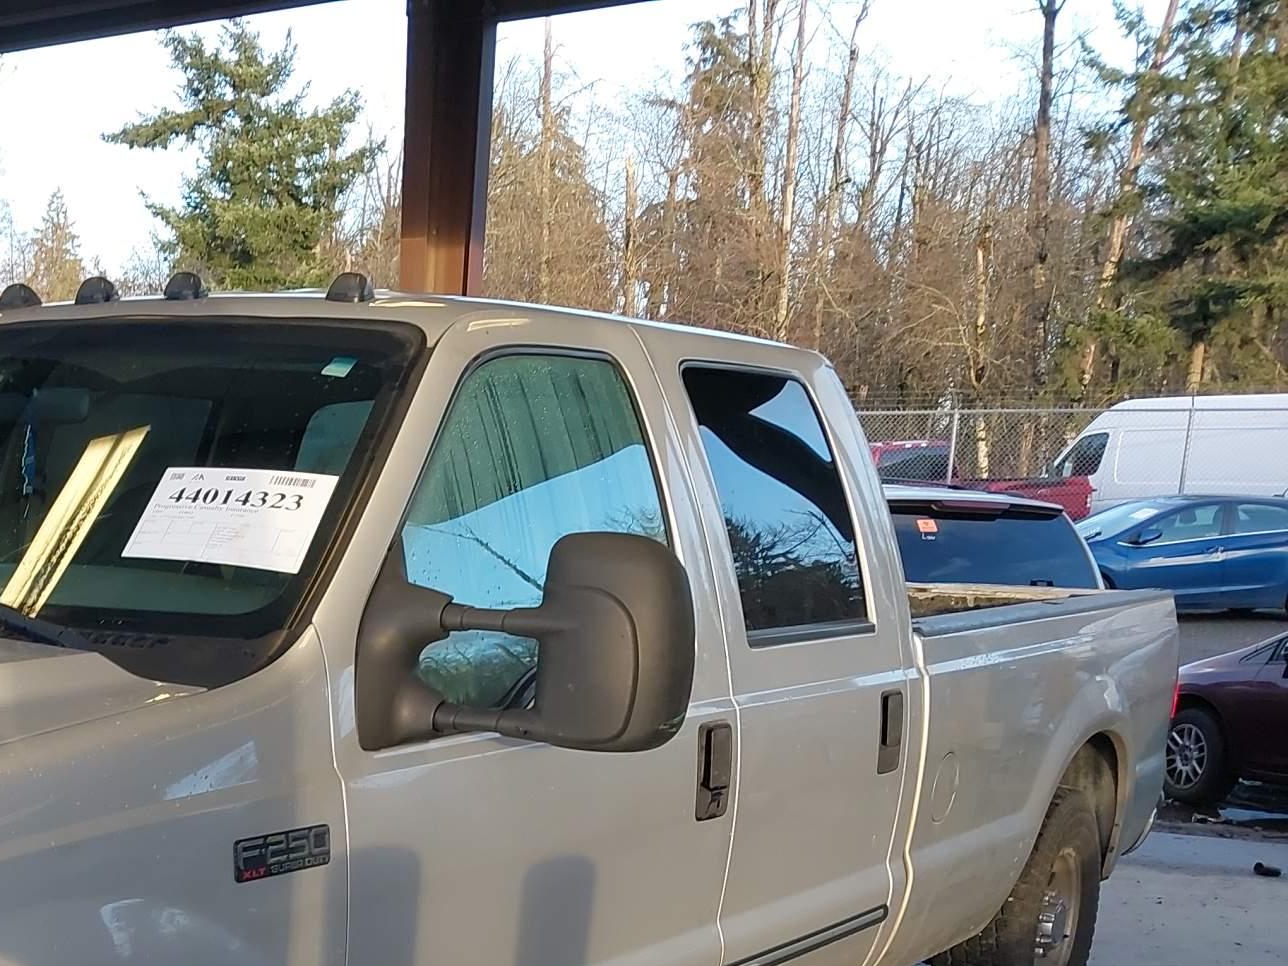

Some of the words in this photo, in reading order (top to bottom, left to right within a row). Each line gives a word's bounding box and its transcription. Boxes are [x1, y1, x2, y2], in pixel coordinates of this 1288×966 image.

[168, 487, 304, 511] 44014323
[242, 867, 266, 880] XLT
[270, 859, 304, 874] SUPER
